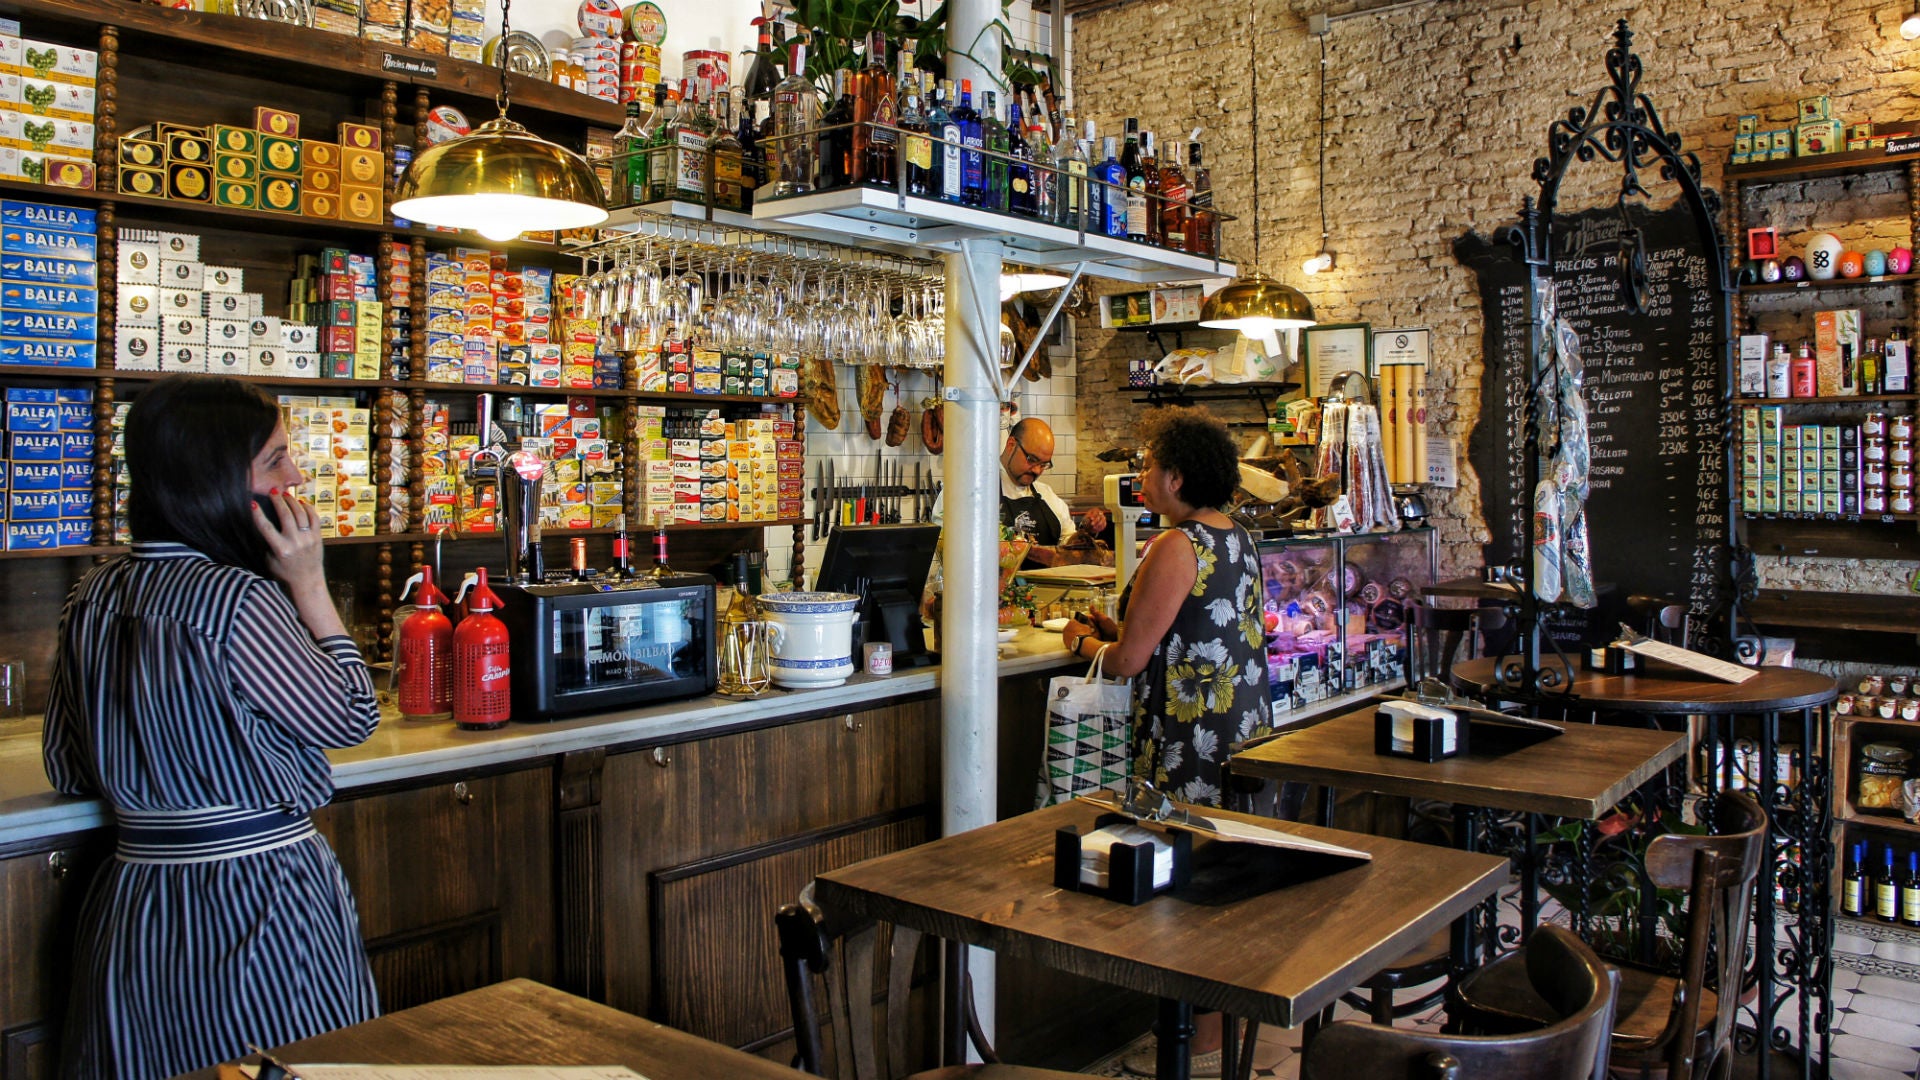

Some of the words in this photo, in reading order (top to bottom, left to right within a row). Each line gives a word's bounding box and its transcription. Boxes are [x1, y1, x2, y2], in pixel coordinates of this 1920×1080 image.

[963, 136, 983, 148] LARIOS
[25, 206, 78, 224] BALEA
[25, 232, 78, 249] BALEA
[1647, 248, 1685, 262] LEVAR
[24, 259, 78, 276] BALEA
[25, 287, 78, 304] BALEA
[24, 315, 78, 331] BALEA
[23, 343, 77, 359] BALEA
[11, 407, 56, 418] BALEA
[14, 436, 59, 447] BALEA
[14, 466, 59, 477] BALEA
[14, 495, 58, 506] BALEA
[10, 525, 55, 536] BALEA
